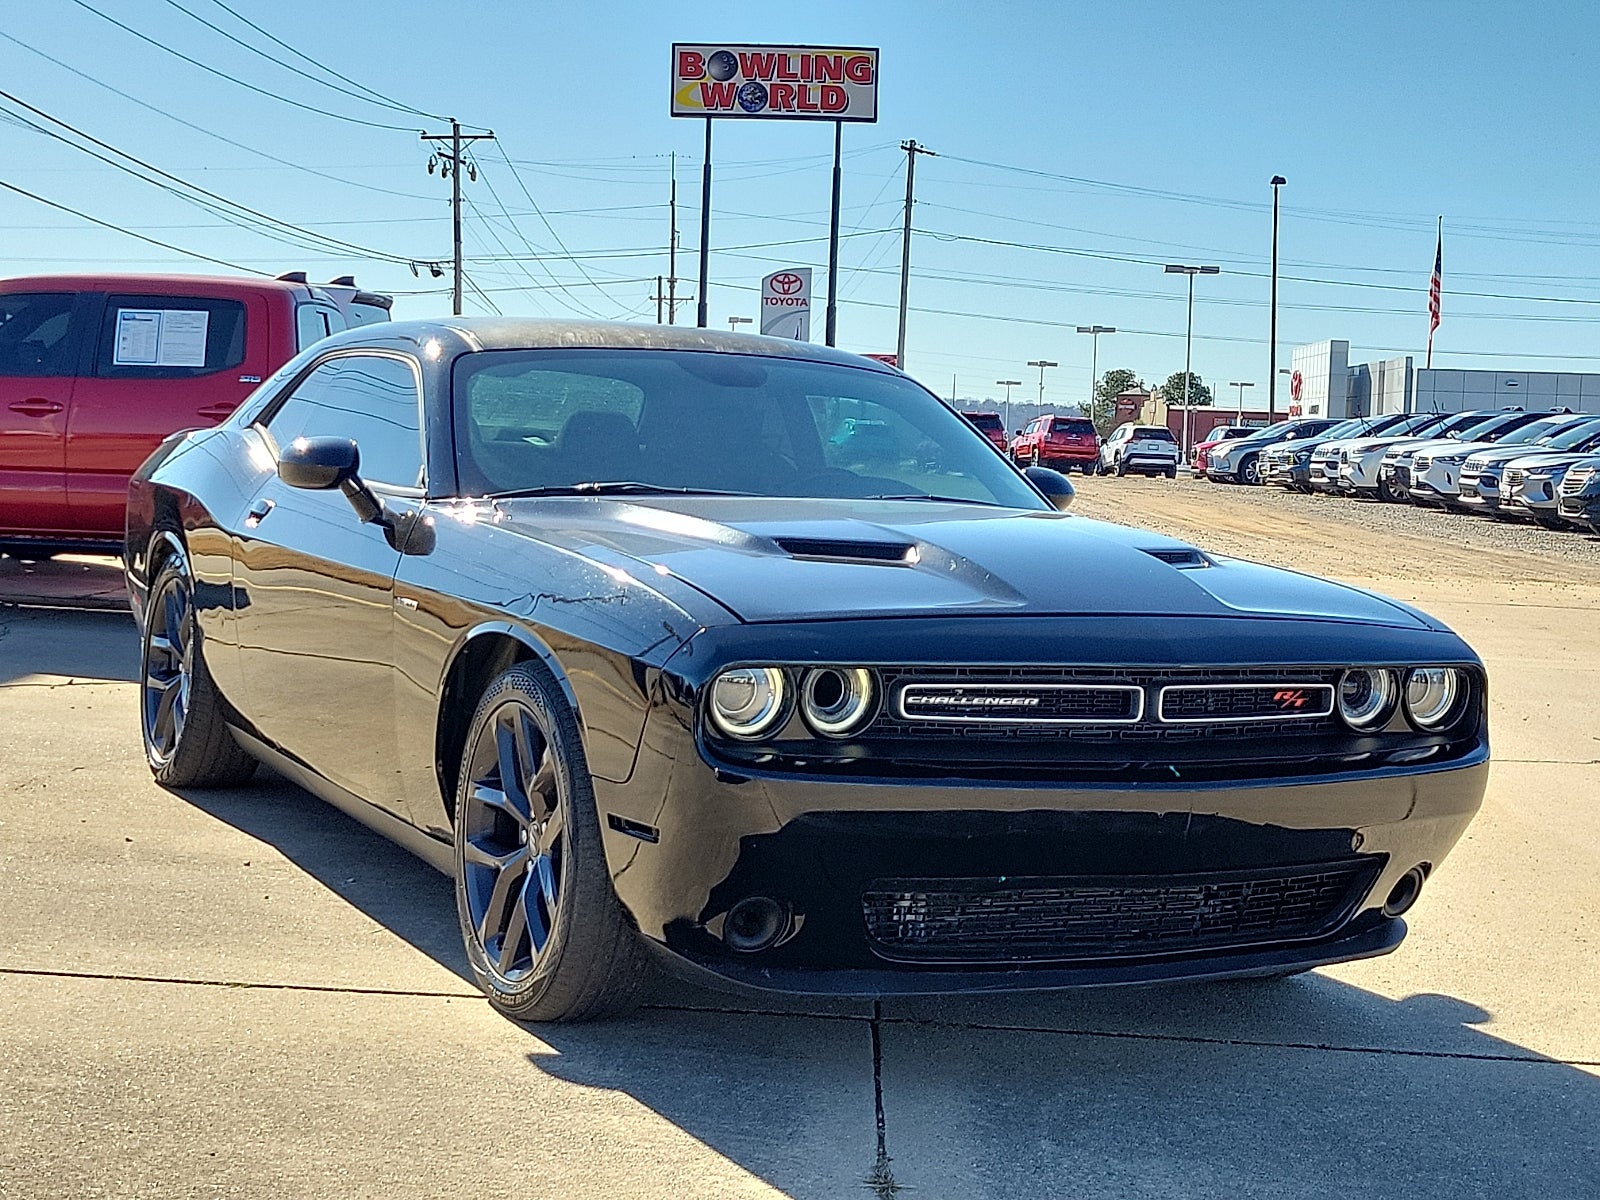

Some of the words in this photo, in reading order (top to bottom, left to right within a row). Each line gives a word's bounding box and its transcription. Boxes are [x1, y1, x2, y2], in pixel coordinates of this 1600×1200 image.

[679, 50, 873, 84] BOWLING
[700, 82, 849, 113] WORLD
[763, 296, 808, 307] TOYOTA
[906, 696, 1040, 706] CHALLENGER
[1273, 690, 1309, 708] R/T
